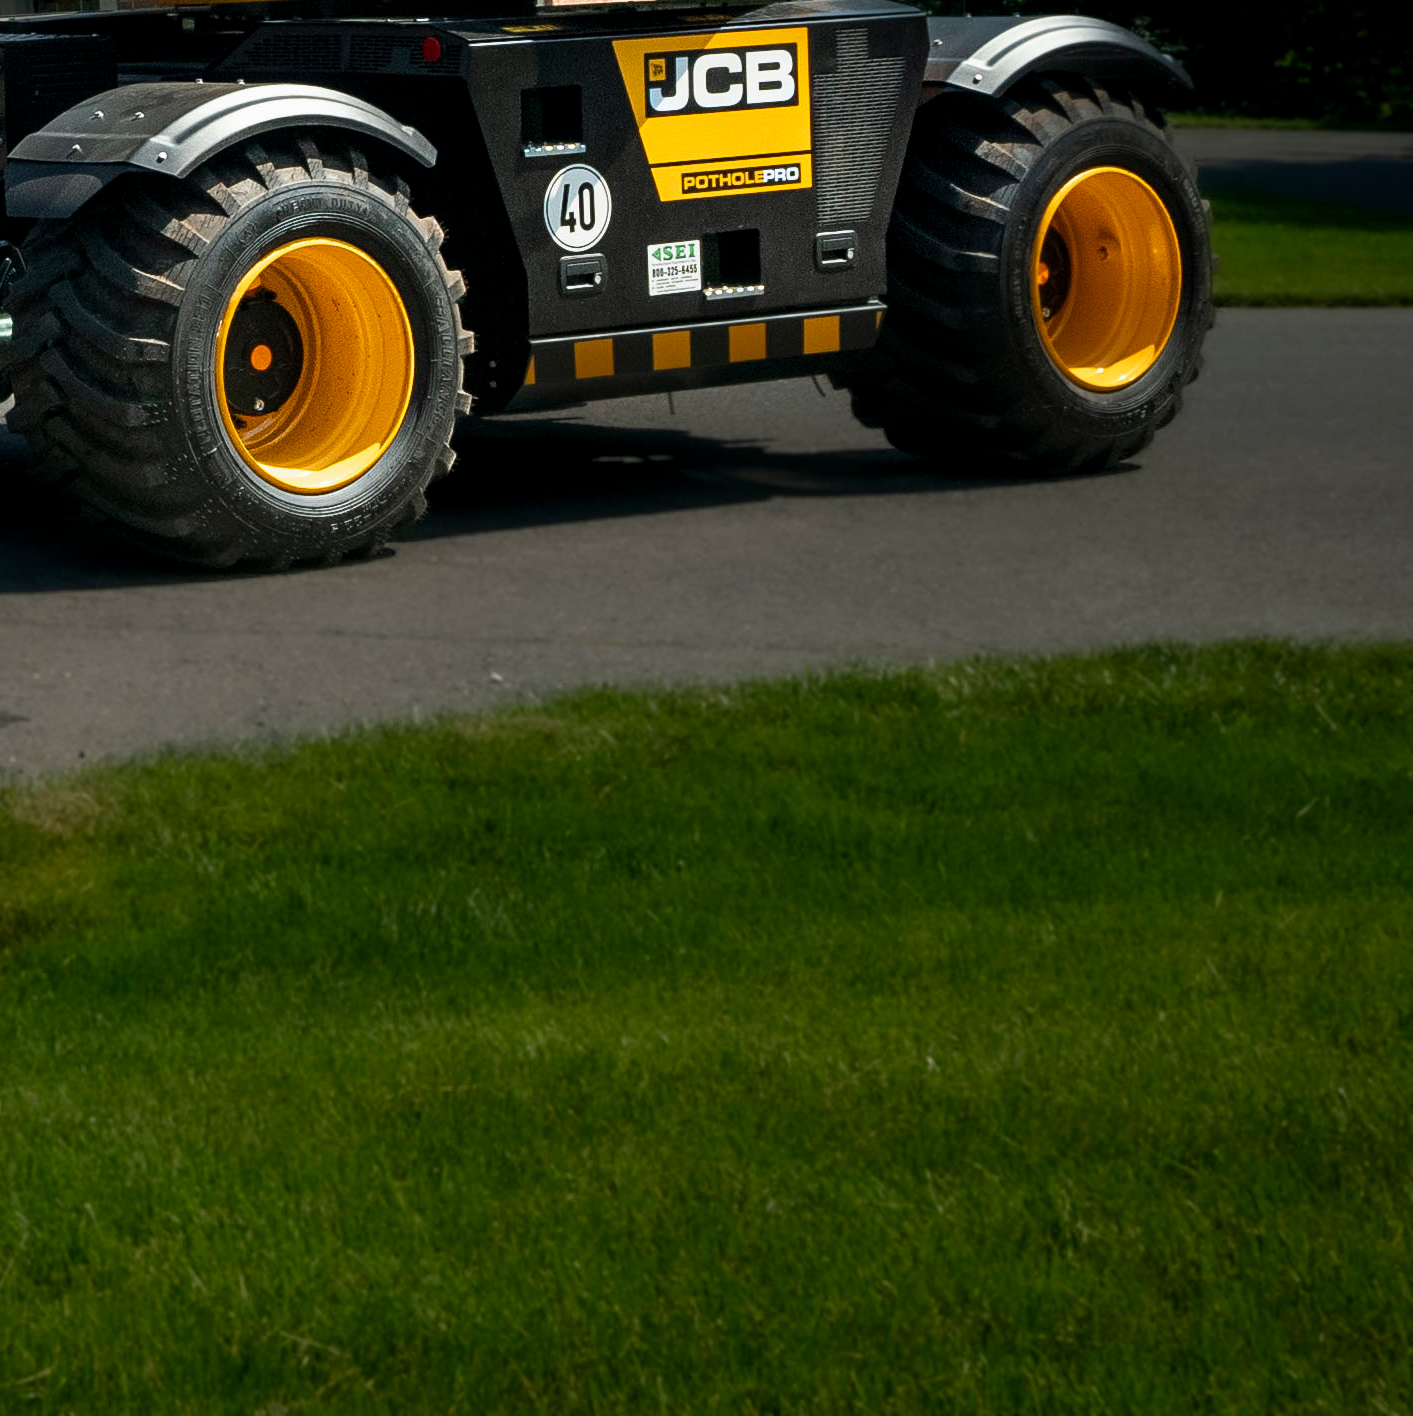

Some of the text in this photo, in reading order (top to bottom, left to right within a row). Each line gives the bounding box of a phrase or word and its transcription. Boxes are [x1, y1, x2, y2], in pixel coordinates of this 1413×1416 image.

[649, 49, 796, 112] JCB
[559, 181, 596, 233] 40
[662, 243, 696, 261] SEI
